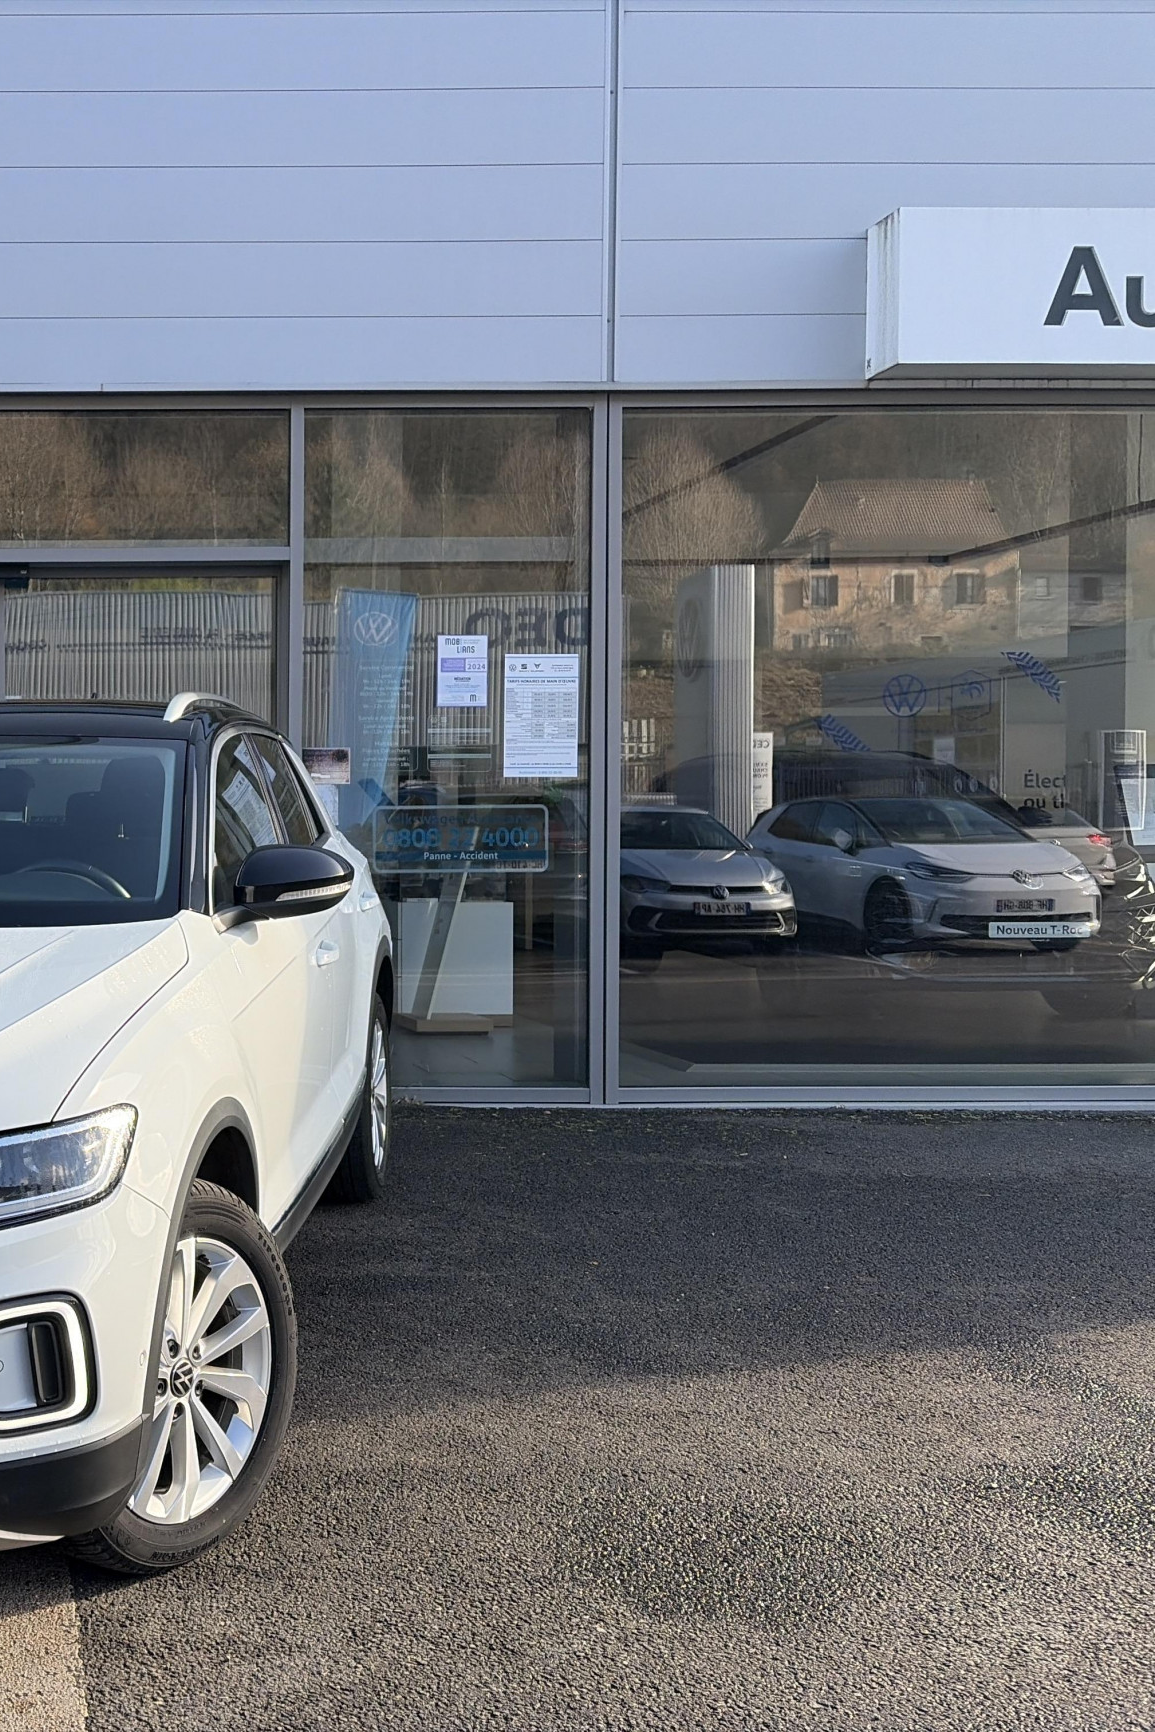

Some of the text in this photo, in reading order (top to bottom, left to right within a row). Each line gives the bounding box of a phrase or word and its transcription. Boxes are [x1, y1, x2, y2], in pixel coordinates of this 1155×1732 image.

[481, 827, 540, 848] 4000
[423, 852, 452, 861] Panne
[459, 851, 498, 861] Accident
[996, 925, 1083, 935] Nouveau T-Roc
